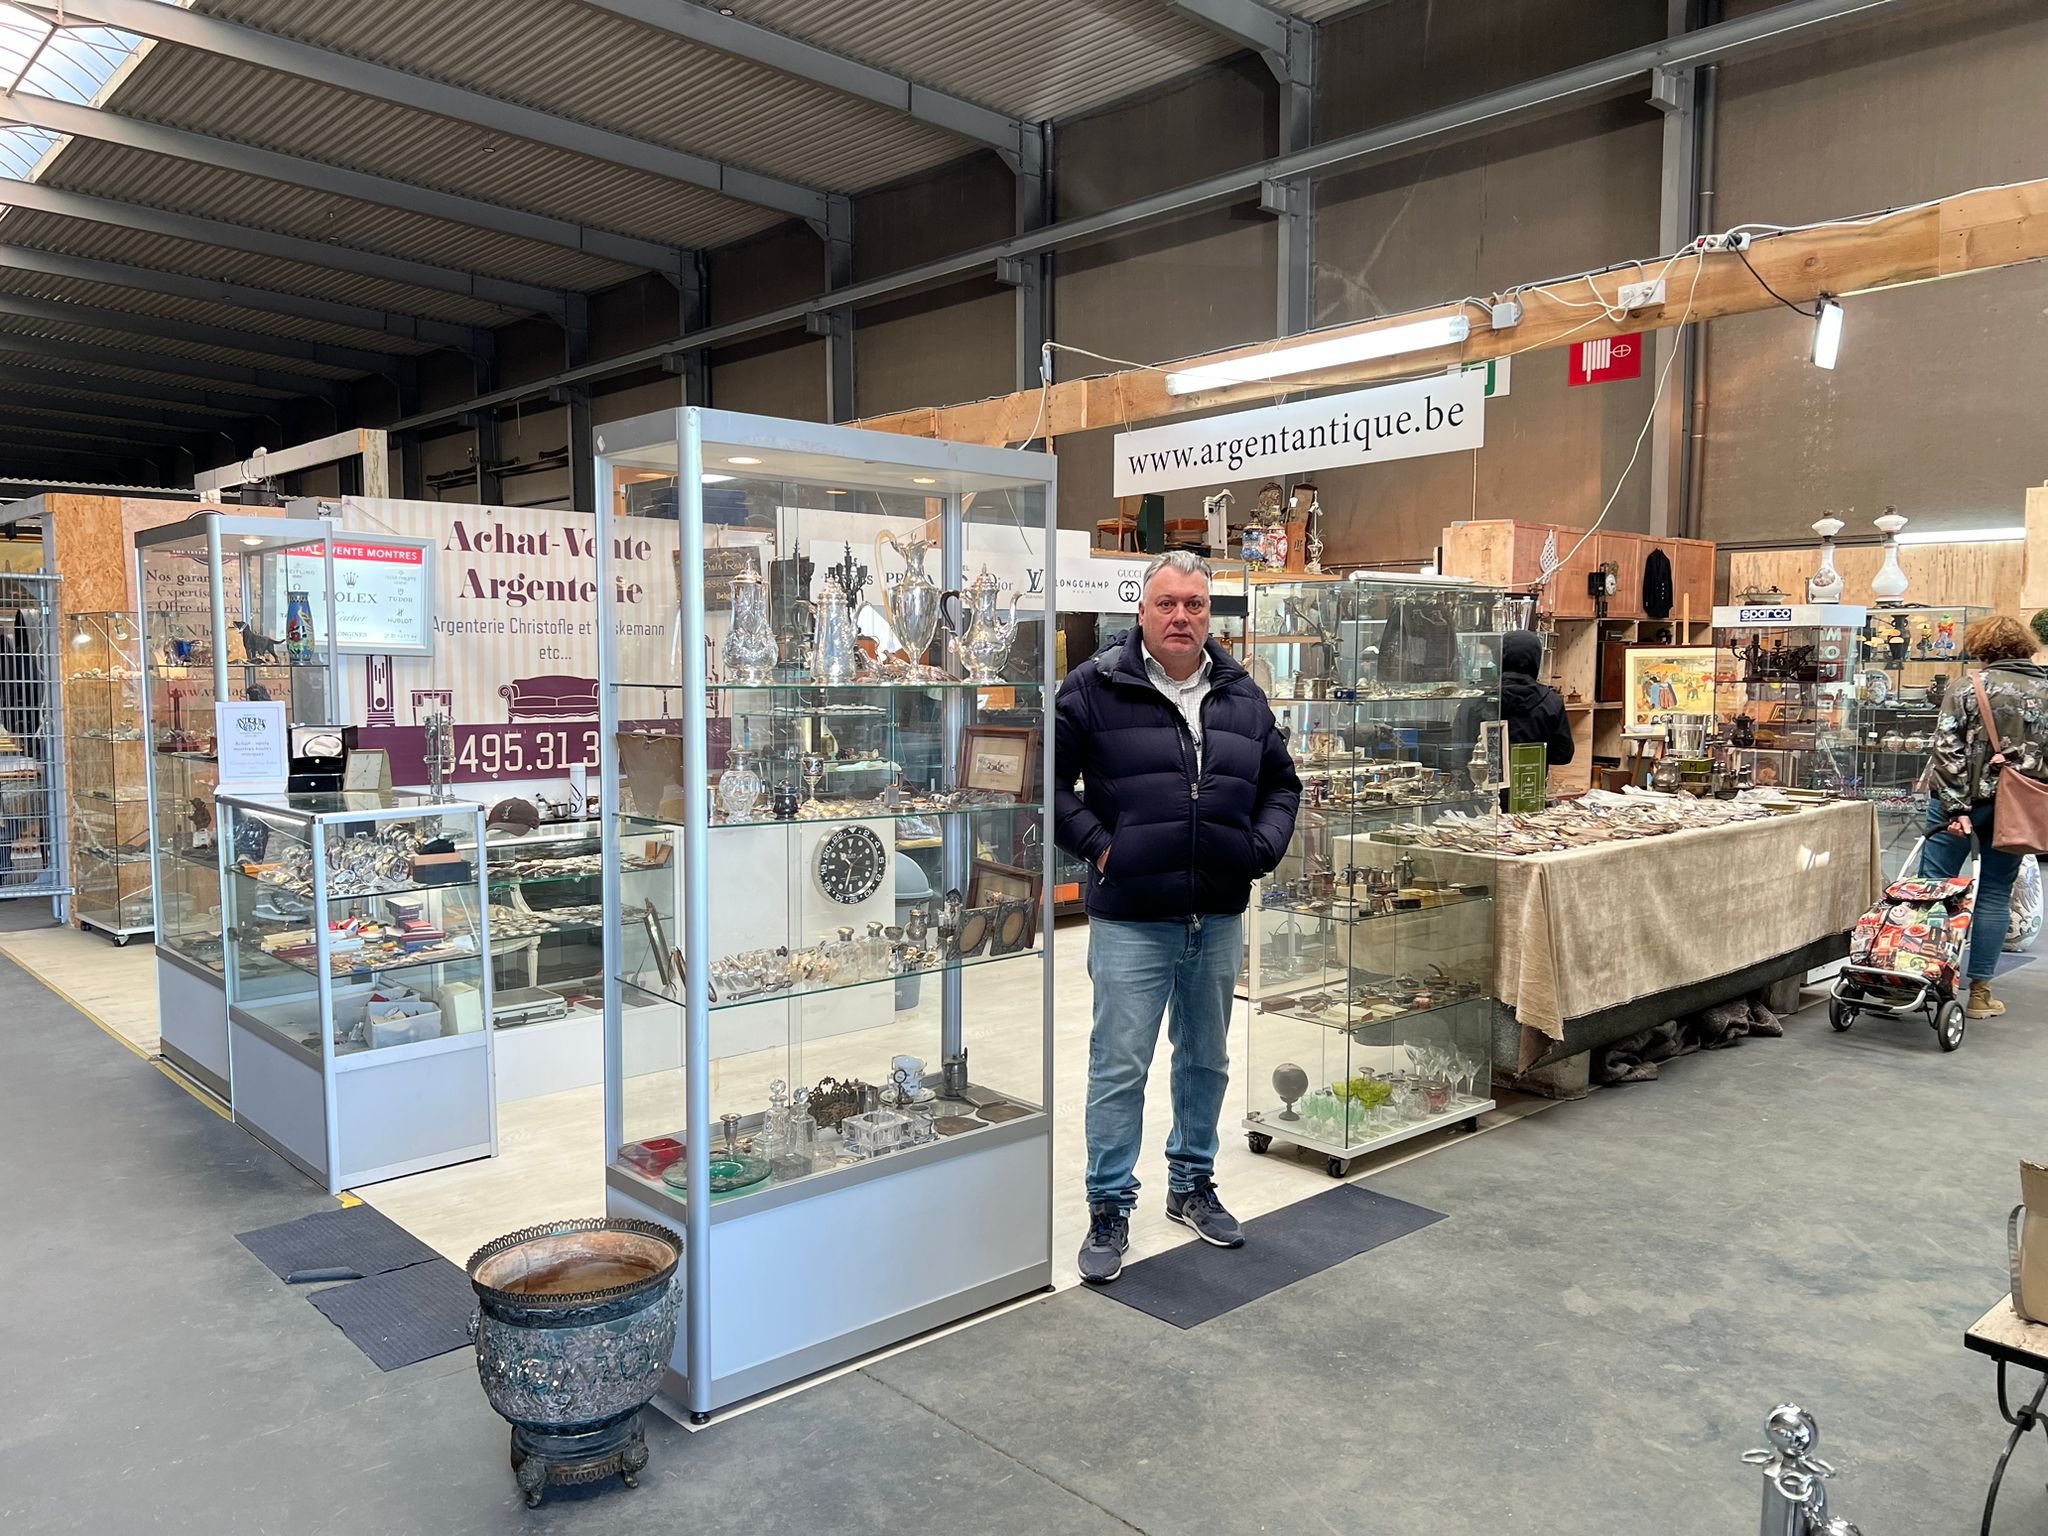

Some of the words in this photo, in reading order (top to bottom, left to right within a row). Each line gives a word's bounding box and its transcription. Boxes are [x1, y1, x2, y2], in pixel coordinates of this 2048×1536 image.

[1128, 395, 1465, 475] www.argentantique.be
[367, 549, 418, 560] MONTRES
[147, 569, 171, 582] Nos
[1117, 569, 1142, 578] GUCCI
[459, 568, 643, 607] Argenteie
[323, 590, 377, 604] OLEX
[158, 600, 192, 613] Offre
[1741, 608, 1791, 620] sparco
[433, 615, 505, 635] Argenterie
[509, 617, 574, 635] Christofle
[579, 621, 591, 635] et
[539, 645, 572, 660] etc...
[832, 832, 843, 843] 22
[823, 846, 832, 858] 20
[821, 864, 827, 875] 18
[835, 893, 843, 902] 14
[864, 889, 873, 898] 10
[849, 896, 858, 904] 12
